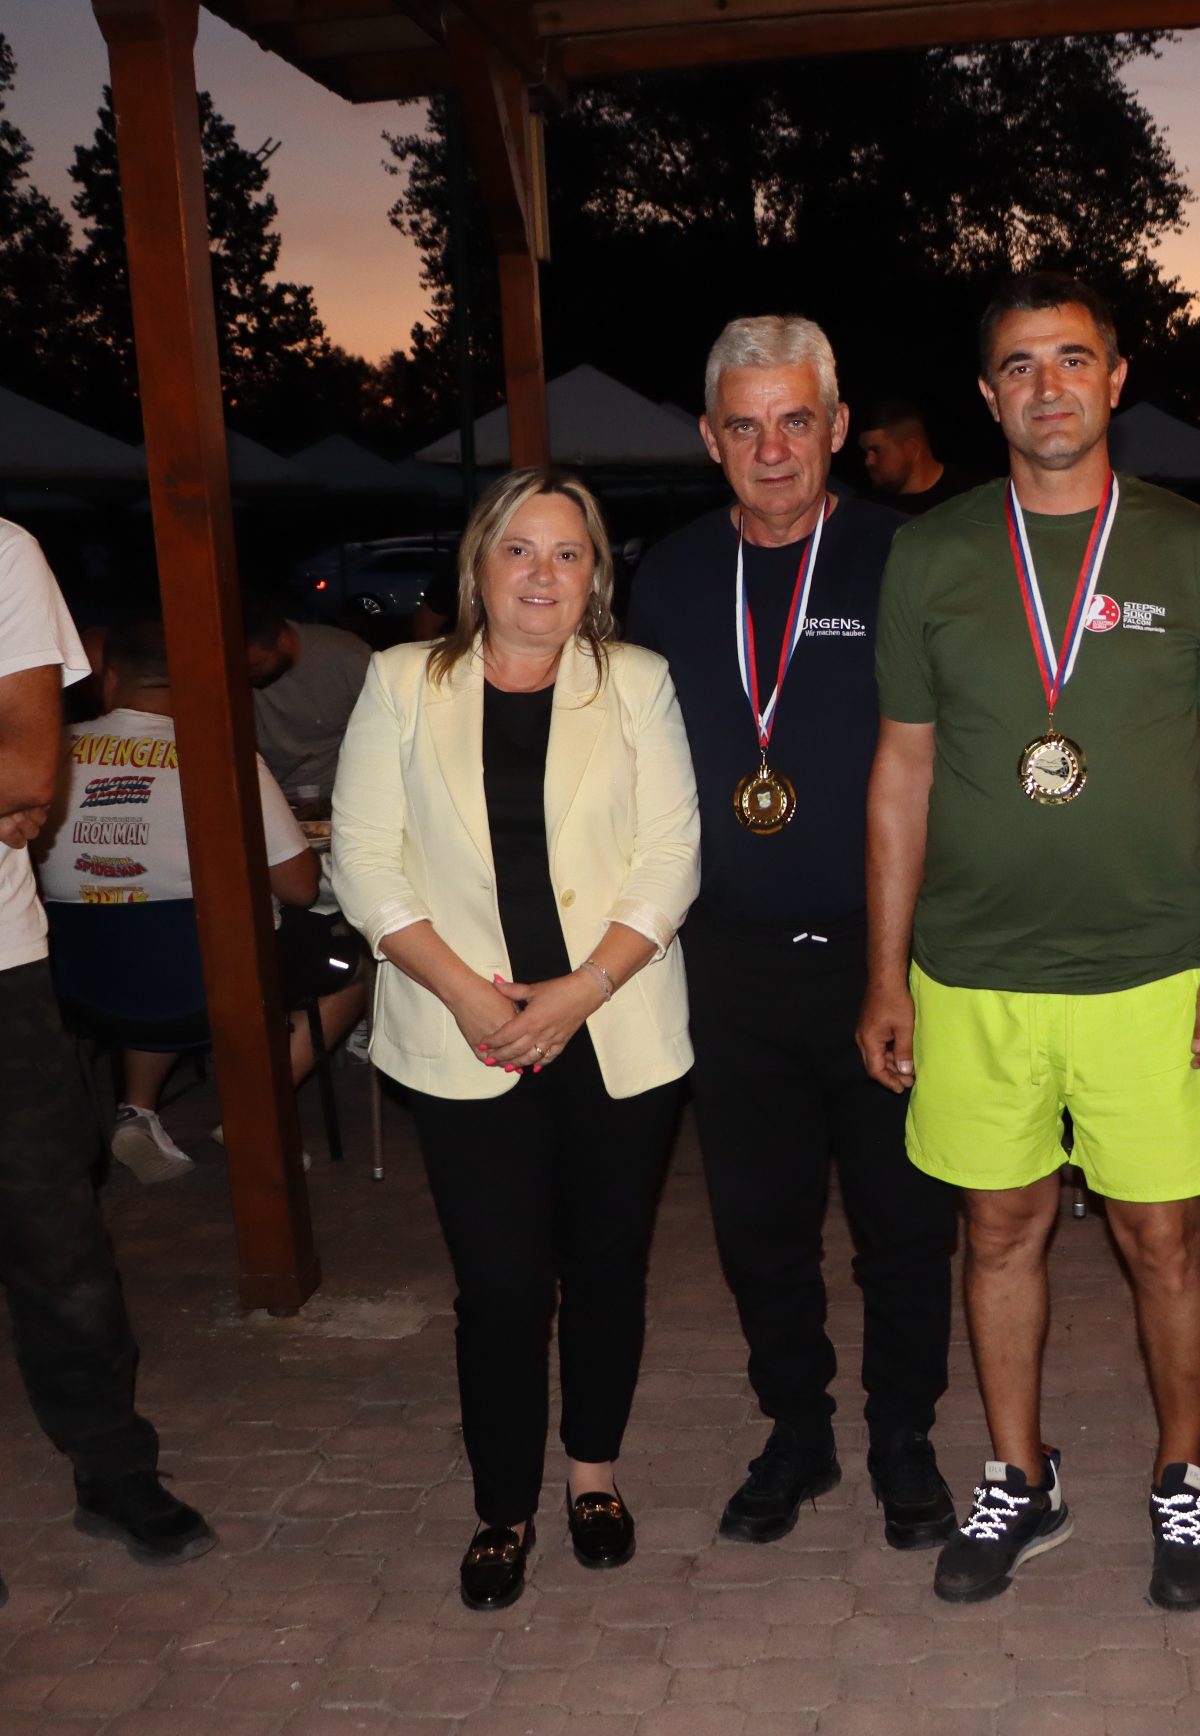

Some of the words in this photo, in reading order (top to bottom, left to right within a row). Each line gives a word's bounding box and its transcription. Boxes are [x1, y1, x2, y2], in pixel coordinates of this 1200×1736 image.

[1123, 602, 1166, 616] STEPSKI
[1123, 610, 1152, 620] SOKO
[1123, 618, 1151, 626] FALCON
[73, 820, 114, 845] IRON
[113, 822, 150, 845] MAN
